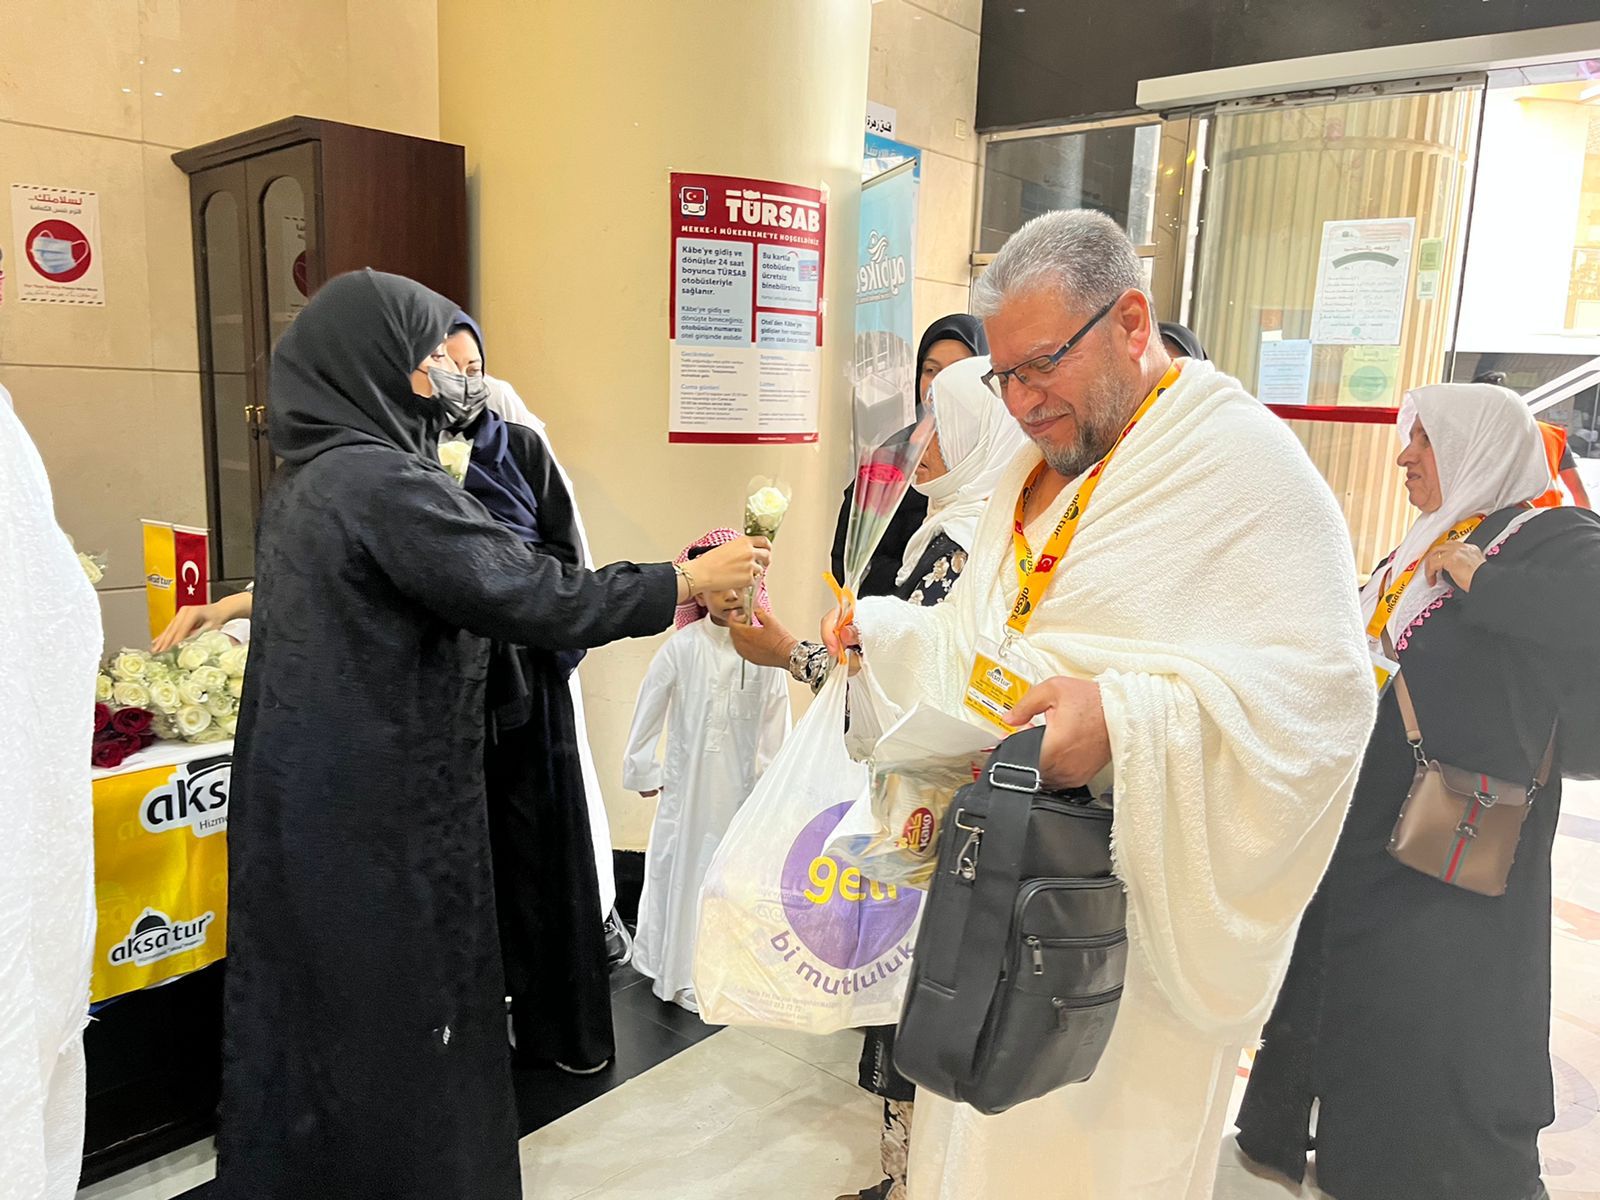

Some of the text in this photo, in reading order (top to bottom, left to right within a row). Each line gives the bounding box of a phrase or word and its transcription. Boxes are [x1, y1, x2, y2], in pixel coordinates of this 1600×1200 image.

[726, 198, 820, 233] TÜRSAB
[681, 225, 819, 246] MEKKE-İ MÜKERREME'YE HOŞGELDİNİZ
[682, 246, 713, 257] Kâbe'ye
[714, 248, 733, 257] gidiş
[682, 256, 717, 266] dönüşler
[772, 253, 790, 261] kartla
[682, 267, 747, 277] boyunca TÜRSAB
[762, 263, 796, 272] otobüslere
[761, 272, 787, 280] ücretsiz
[681, 277, 733, 287] otobüsleriyle
[682, 287, 715, 296] sağlanır.
[707, 306, 722, 314] gidiş
[1054, 493, 1079, 537] aksa tur
[112, 932, 170, 962] aksa
[173, 917, 208, 941] tur
[770, 929, 916, 997] bi mutluluk
